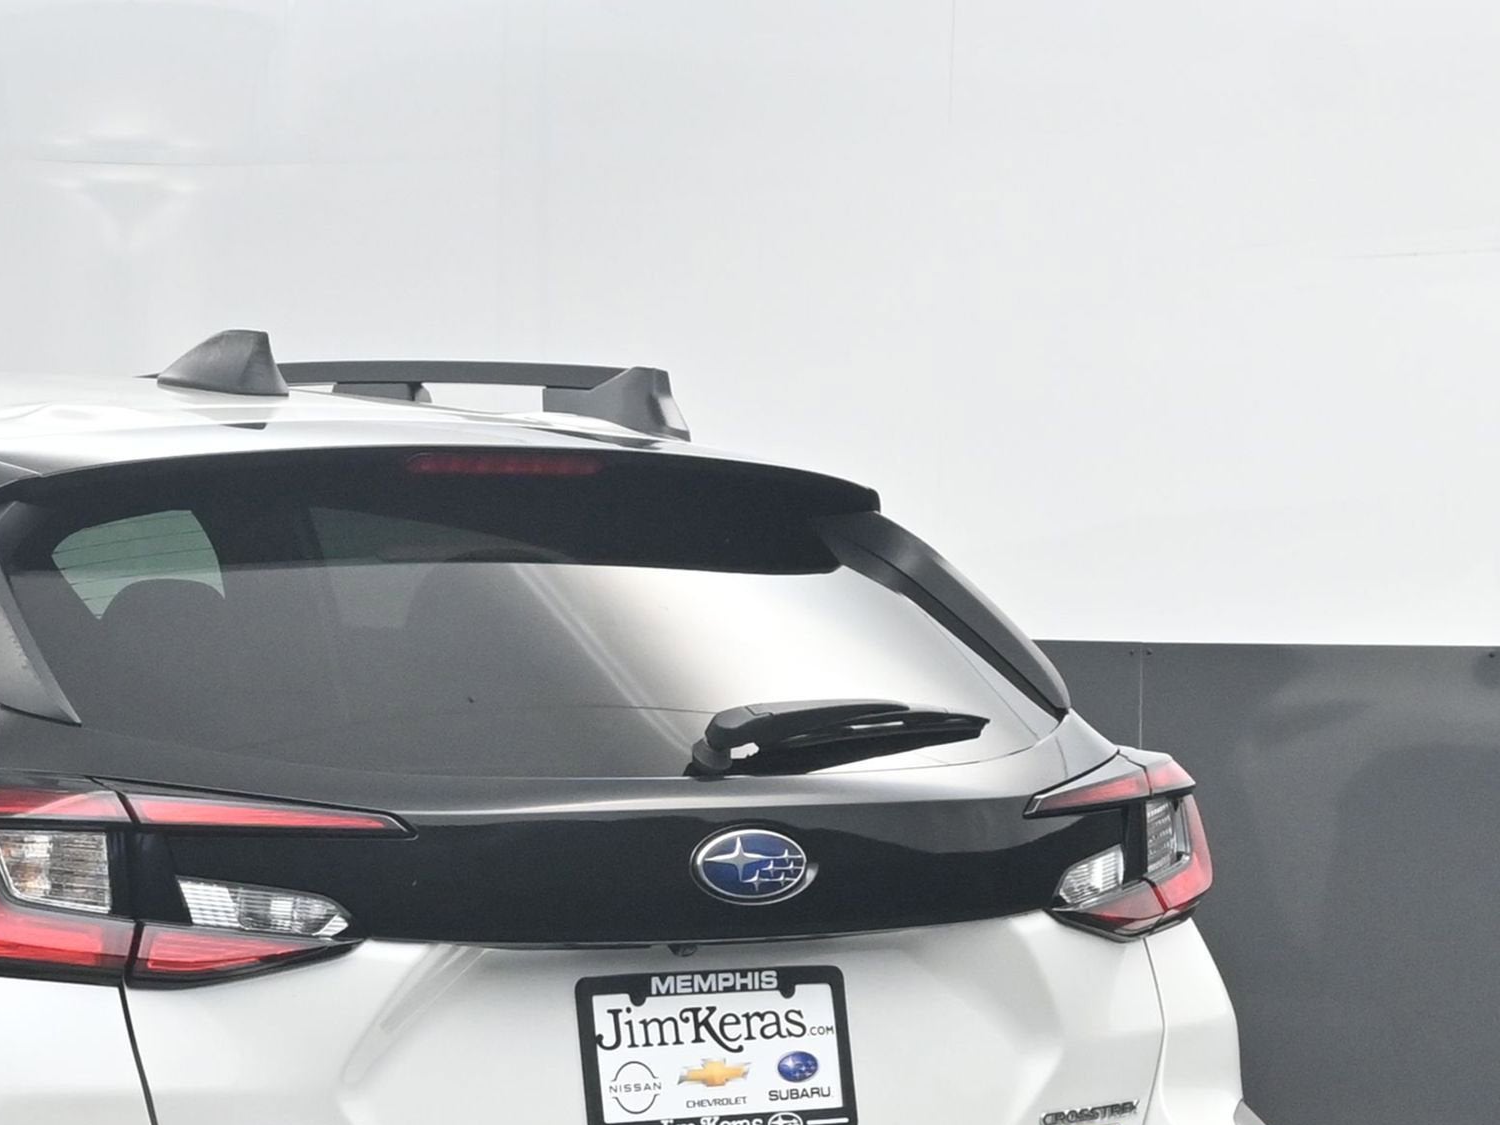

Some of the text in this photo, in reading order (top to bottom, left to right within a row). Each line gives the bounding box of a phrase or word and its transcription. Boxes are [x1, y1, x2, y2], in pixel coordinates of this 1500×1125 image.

[651, 970, 778, 996] MEMPHIS
[609, 1082, 662, 1094] NISSAN
[768, 1086, 832, 1102] SUBARU
[686, 1096, 747, 1109] CHEVROLET
